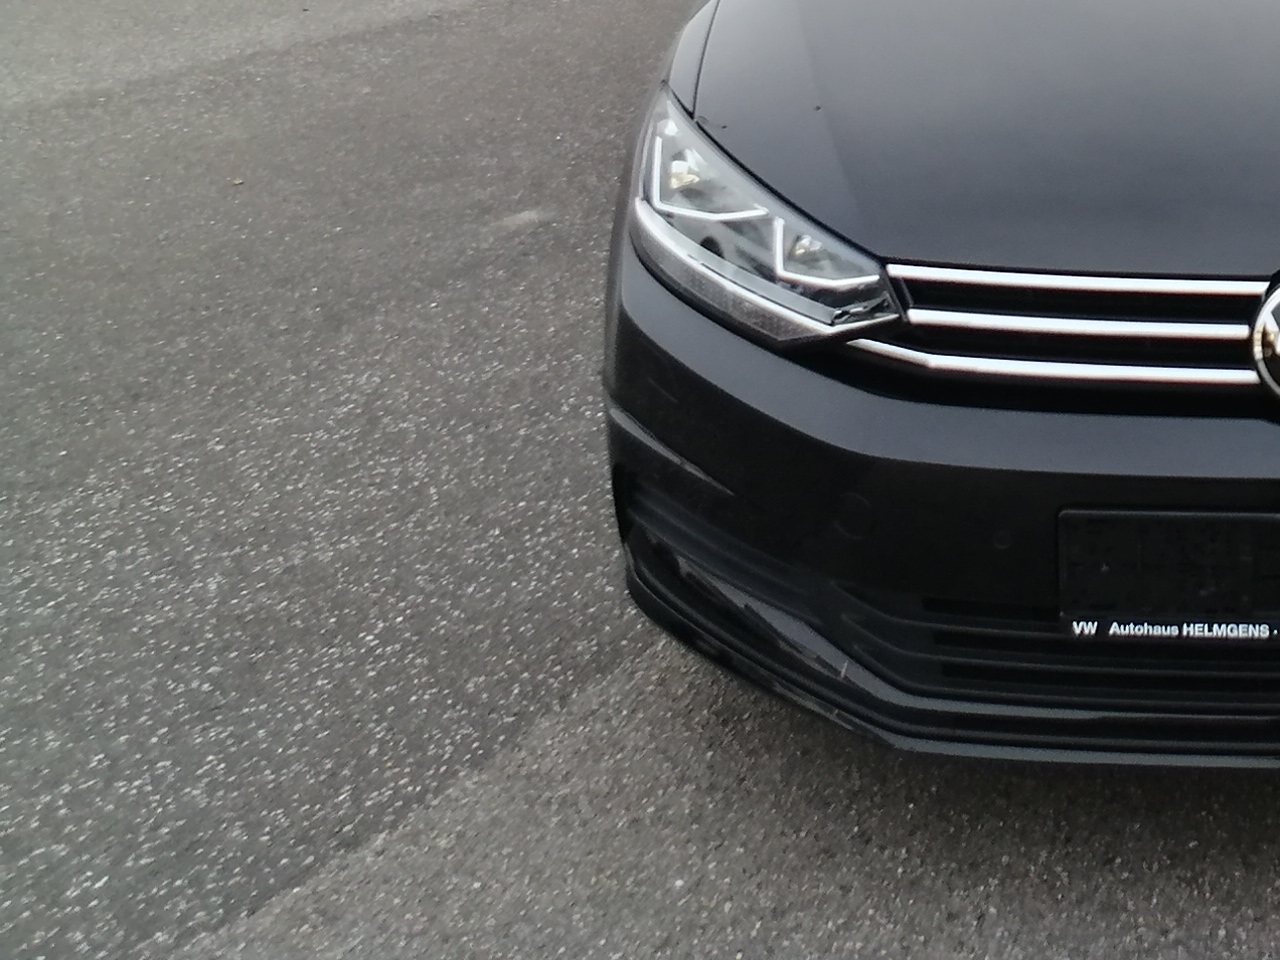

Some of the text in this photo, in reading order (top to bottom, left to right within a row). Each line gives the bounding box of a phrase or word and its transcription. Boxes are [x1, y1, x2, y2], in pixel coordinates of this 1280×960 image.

[1072, 621, 1098, 636] VW
[1109, 621, 1179, 637] Autohaus
[1182, 623, 1270, 638] HELMGENS
